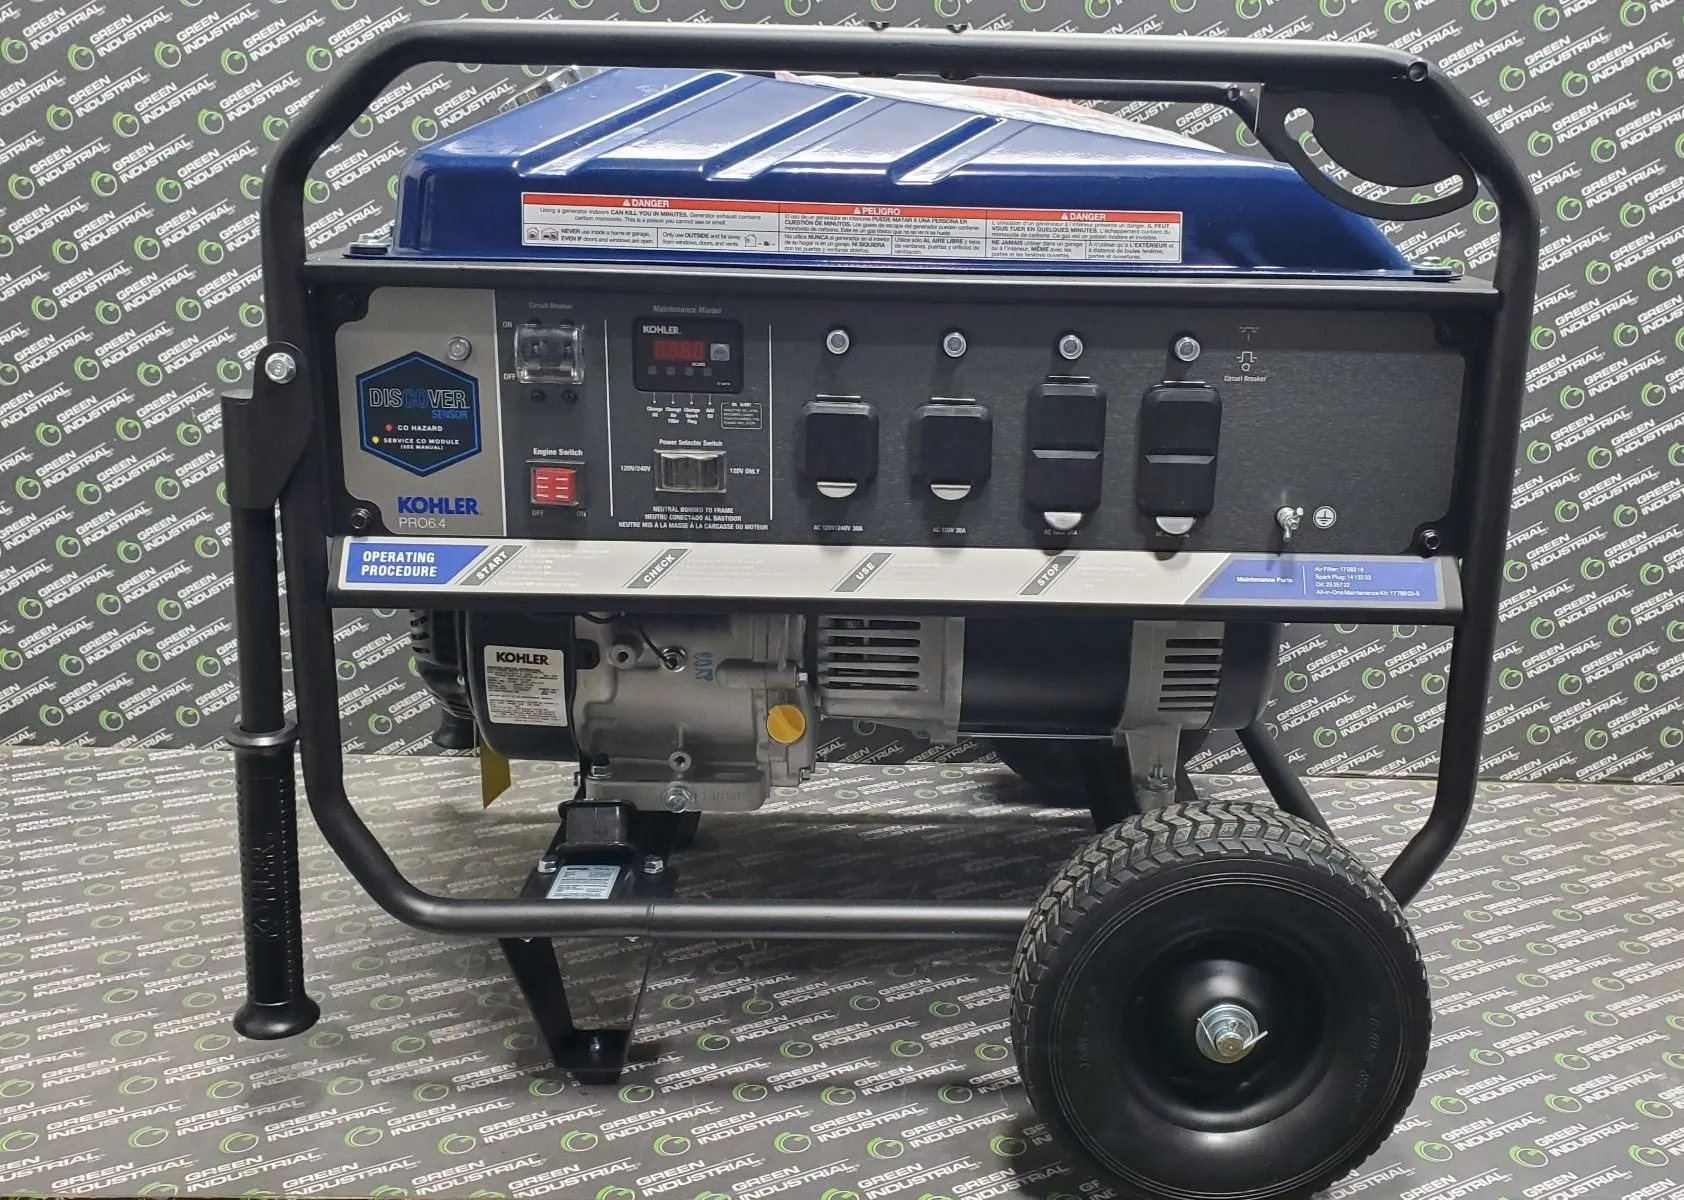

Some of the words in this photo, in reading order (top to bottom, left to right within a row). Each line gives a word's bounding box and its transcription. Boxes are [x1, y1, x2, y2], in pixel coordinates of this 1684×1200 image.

[22, 7, 66, 38] GREEN
[30, 4, 102, 50] INDUSTRIAL
[1524, 35, 1571, 66] GREEN
[1529, 33, 1609, 78] INDUSTRIAL
[1552, 101, 1599, 131] GREEN
[1557, 98, 1636, 144] INDUSTRIAL
[112, 142, 155, 172] GREEN
[119, 139, 191, 184] INDUSTRIAL
[632, 199, 669, 208] DANGER
[862, 208, 900, 216] PELIGRO
[1070, 213, 1106, 221] DANGER
[653, 305, 696, 314] Maintenance
[698, 306, 722, 315] Minder
[642, 325, 680, 335] KOHLER
[369, 388, 467, 409] DISCOVER
[431, 409, 467, 421] SENSOR
[533, 447, 557, 457] Engine
[559, 448, 583, 457] Switch
[659, 438, 677, 447] Power
[678, 439, 702, 447] Selector
[1578, 473, 1622, 500] GREEN
[1583, 470, 1658, 511] INDUSTRIAL
[397, 496, 479, 515] KOHLER
[137, 514, 178, 540] GREEN
[144, 511, 211, 552] INDUSTRIAL
[399, 517, 446, 528] PRO6.4
[745, 523, 768, 531] MOTEUR
[363, 550, 435, 563] OPERATING
[475, 552, 508, 580] START
[643, 553, 675, 583] CHECK
[361, 564, 438, 577] PROCEDURE
[855, 561, 876, 581] USE
[1037, 563, 1061, 588] STOP
[18, 622, 58, 649] GREEN
[25, 619, 91, 659] INDUSTRIAL
[496, 652, 550, 666] KOHLER
[1276, 696, 1319, 722] GREEN
[1281, 694, 1354, 731] INDUSTRIAL
[1549, 699, 1592, 724] GREEN
[1554, 696, 1625, 734] INDUSTRIAL
[1472, 923, 1514, 939] GREEN
[1484, 922, 1552, 945] INDUSTRIAL
[694, 976, 750, 994] GREEN
[700, 974, 793, 1002] INDUSTRIAL
[654, 1063, 716, 1084] GREEN
[661, 1060, 765, 1093] INDUSTRIAL
[1456, 1074, 1508, 1096] GREEN
[1468, 1071, 1553, 1104] INDUSTRIAL
[175, 1102, 250, 1126] GREEN
[177, 1099, 305, 1136] INDUSTRIAL
[810, 1109, 872, 1132] GREEN
[817, 1106, 923, 1143] INDUSTRIAL
